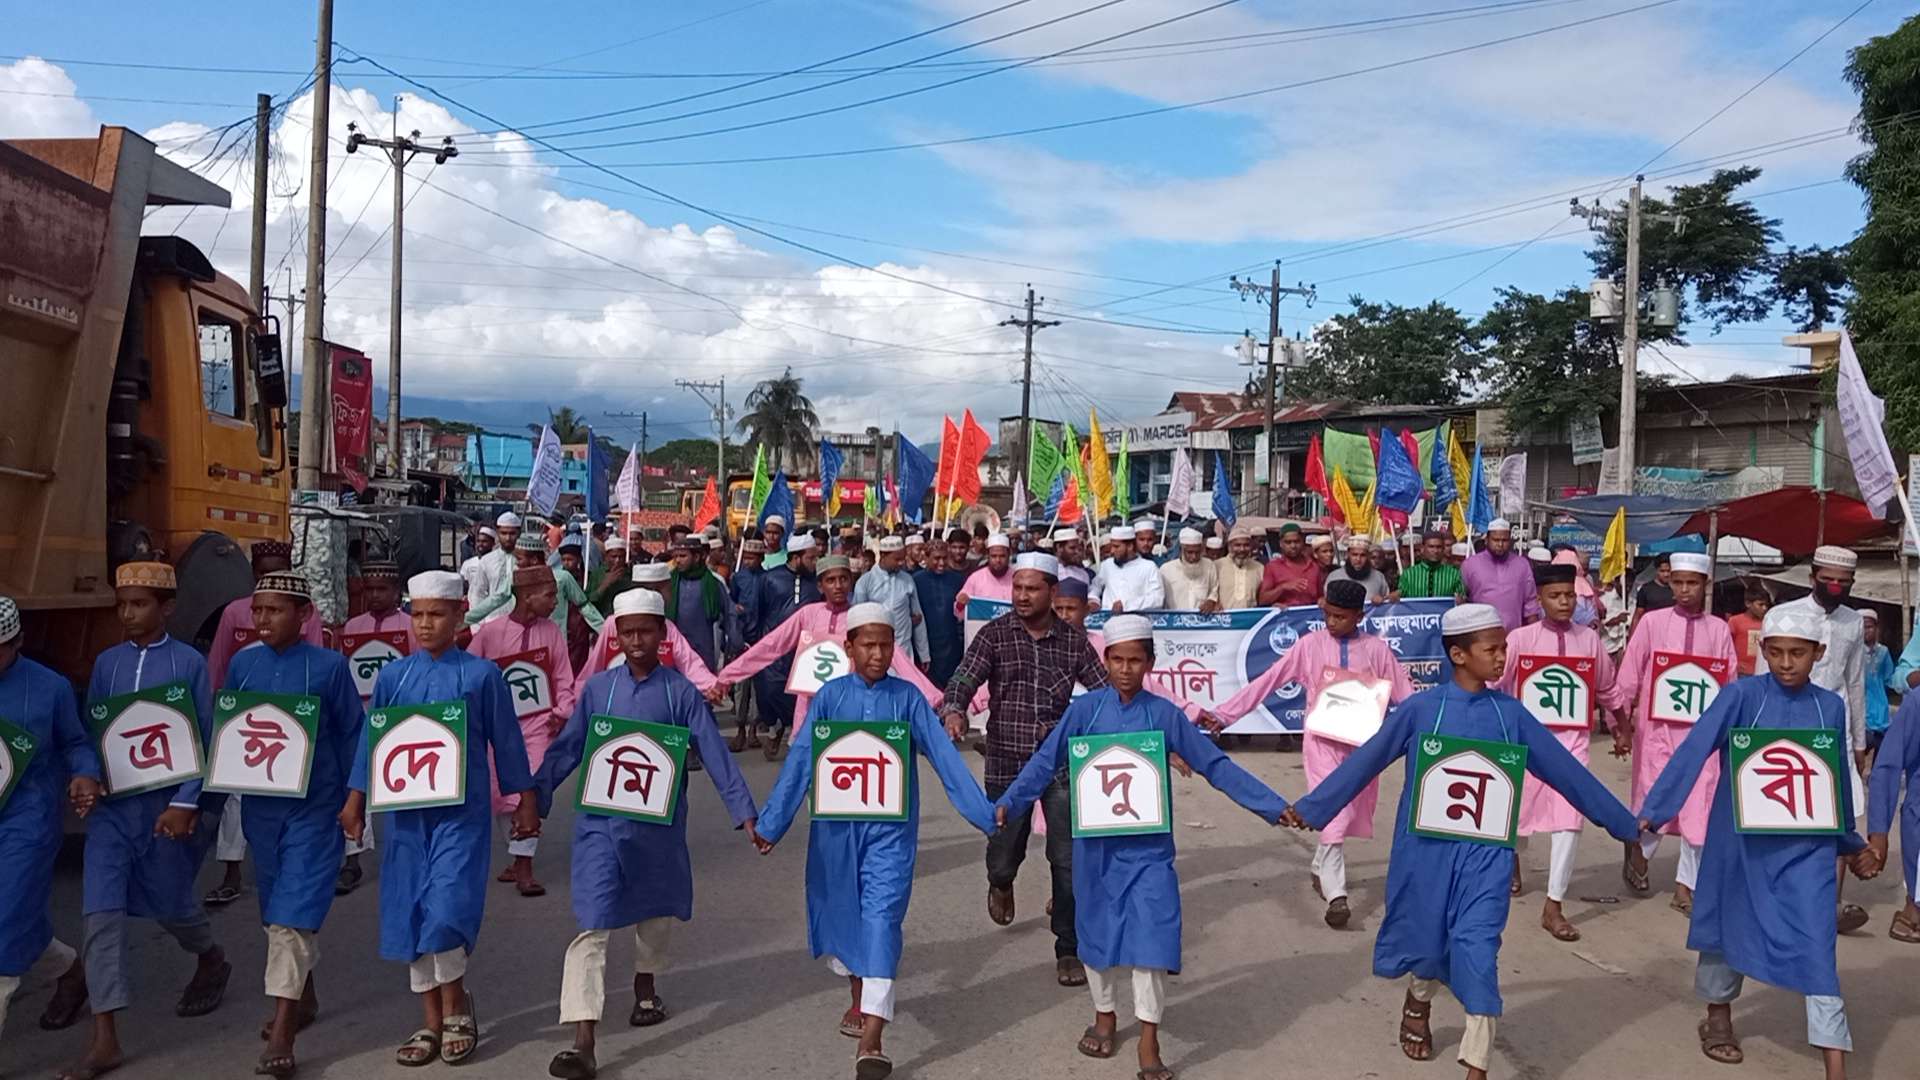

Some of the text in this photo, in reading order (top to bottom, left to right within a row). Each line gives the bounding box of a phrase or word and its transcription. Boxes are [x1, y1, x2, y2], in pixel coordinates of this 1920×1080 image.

[1143, 424, 1188, 441] MARCEL
[1164, 639, 1219, 657] উপলক্ষে
[1371, 614, 1441, 634] আনজুমানে
[813, 645, 841, 683] ই
[1533, 668, 1582, 719] মী
[1665, 678, 1711, 715] য়া
[119, 722, 173, 771] ত্র
[237, 712, 290, 783] ঈ
[382, 740, 447, 793] দে
[605, 745, 661, 806] মি
[826, 750, 892, 807] লা
[1093, 762, 1141, 821] দু
[1441, 767, 1497, 831] ন্ন
[1752, 747, 1819, 821] বী
